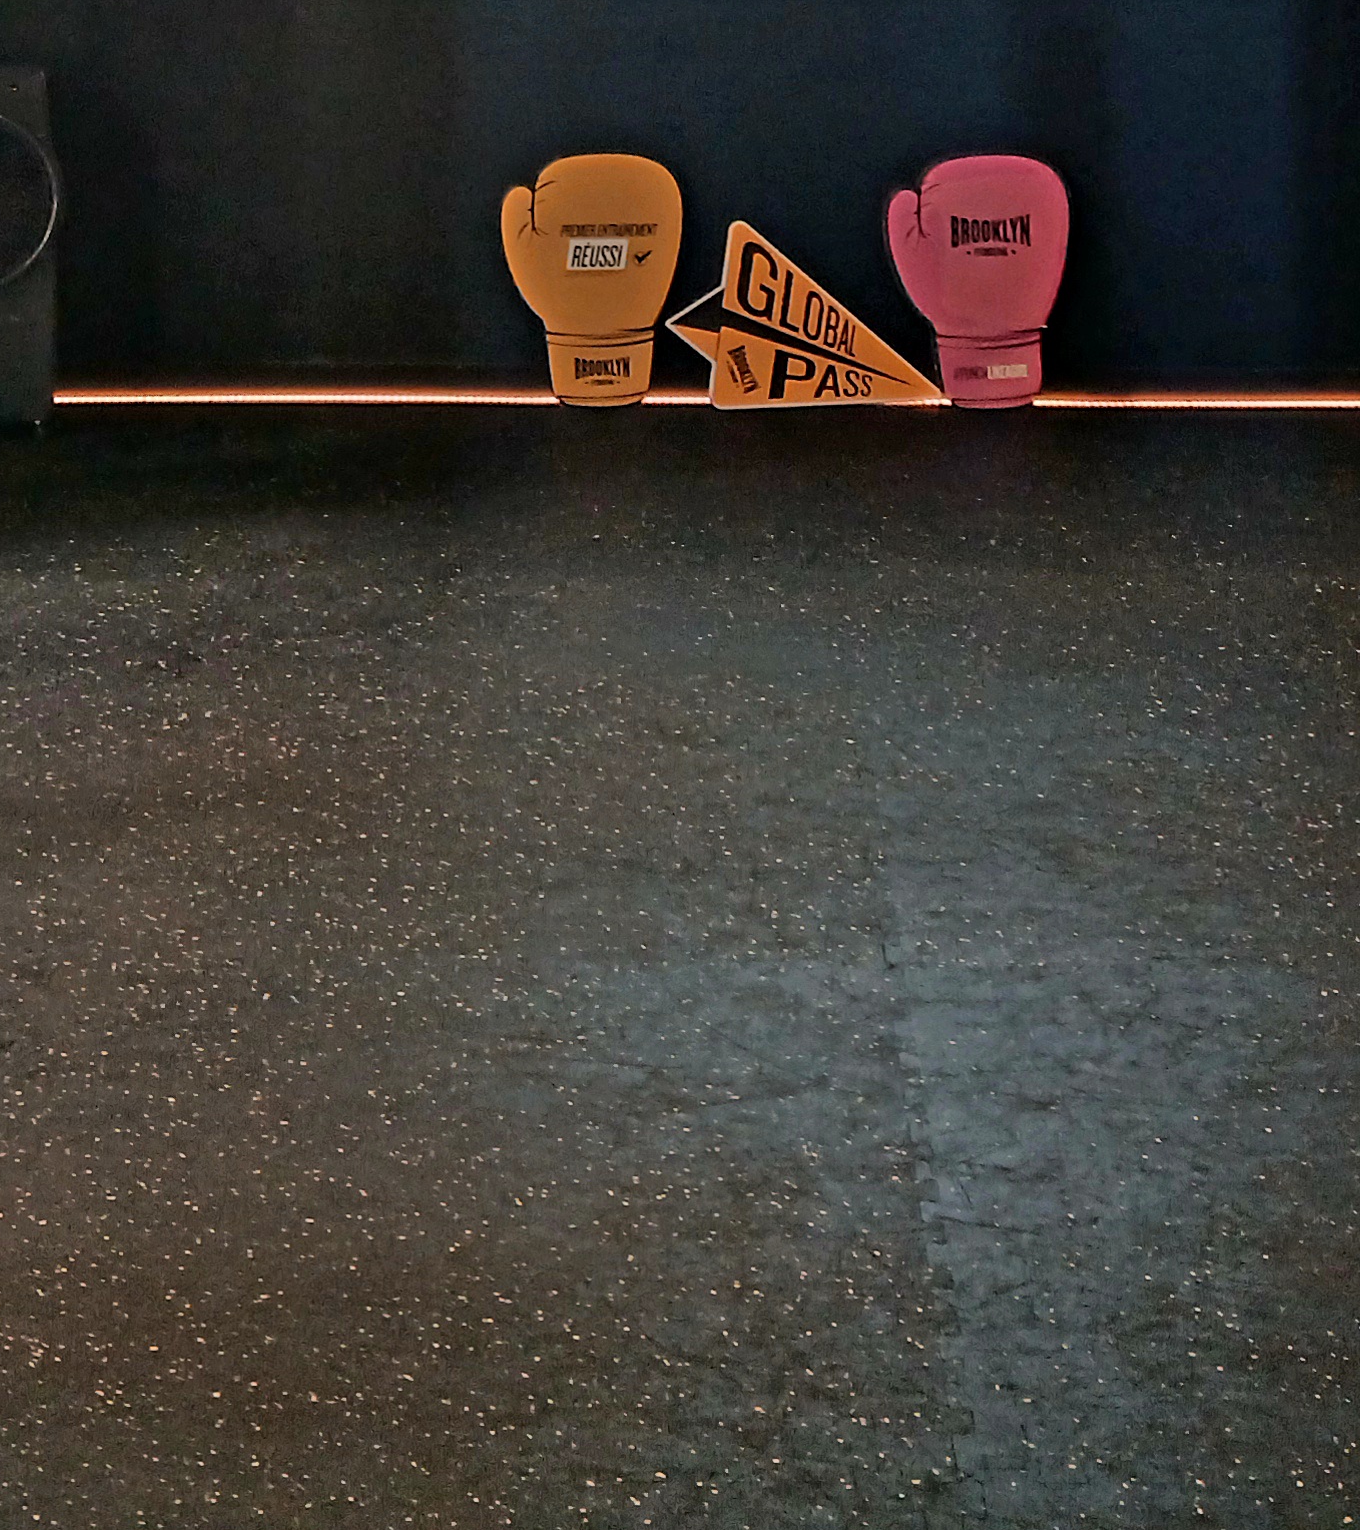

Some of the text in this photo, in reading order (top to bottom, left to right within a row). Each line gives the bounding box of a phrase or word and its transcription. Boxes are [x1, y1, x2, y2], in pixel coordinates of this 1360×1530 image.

[951, 214, 1031, 247] BROOKLYN
[571, 242, 623, 267] RÉUSSI
[737, 241, 856, 357] GLOBAL
[575, 357, 630, 379] BROOKLYN
[768, 349, 873, 399] PASS
